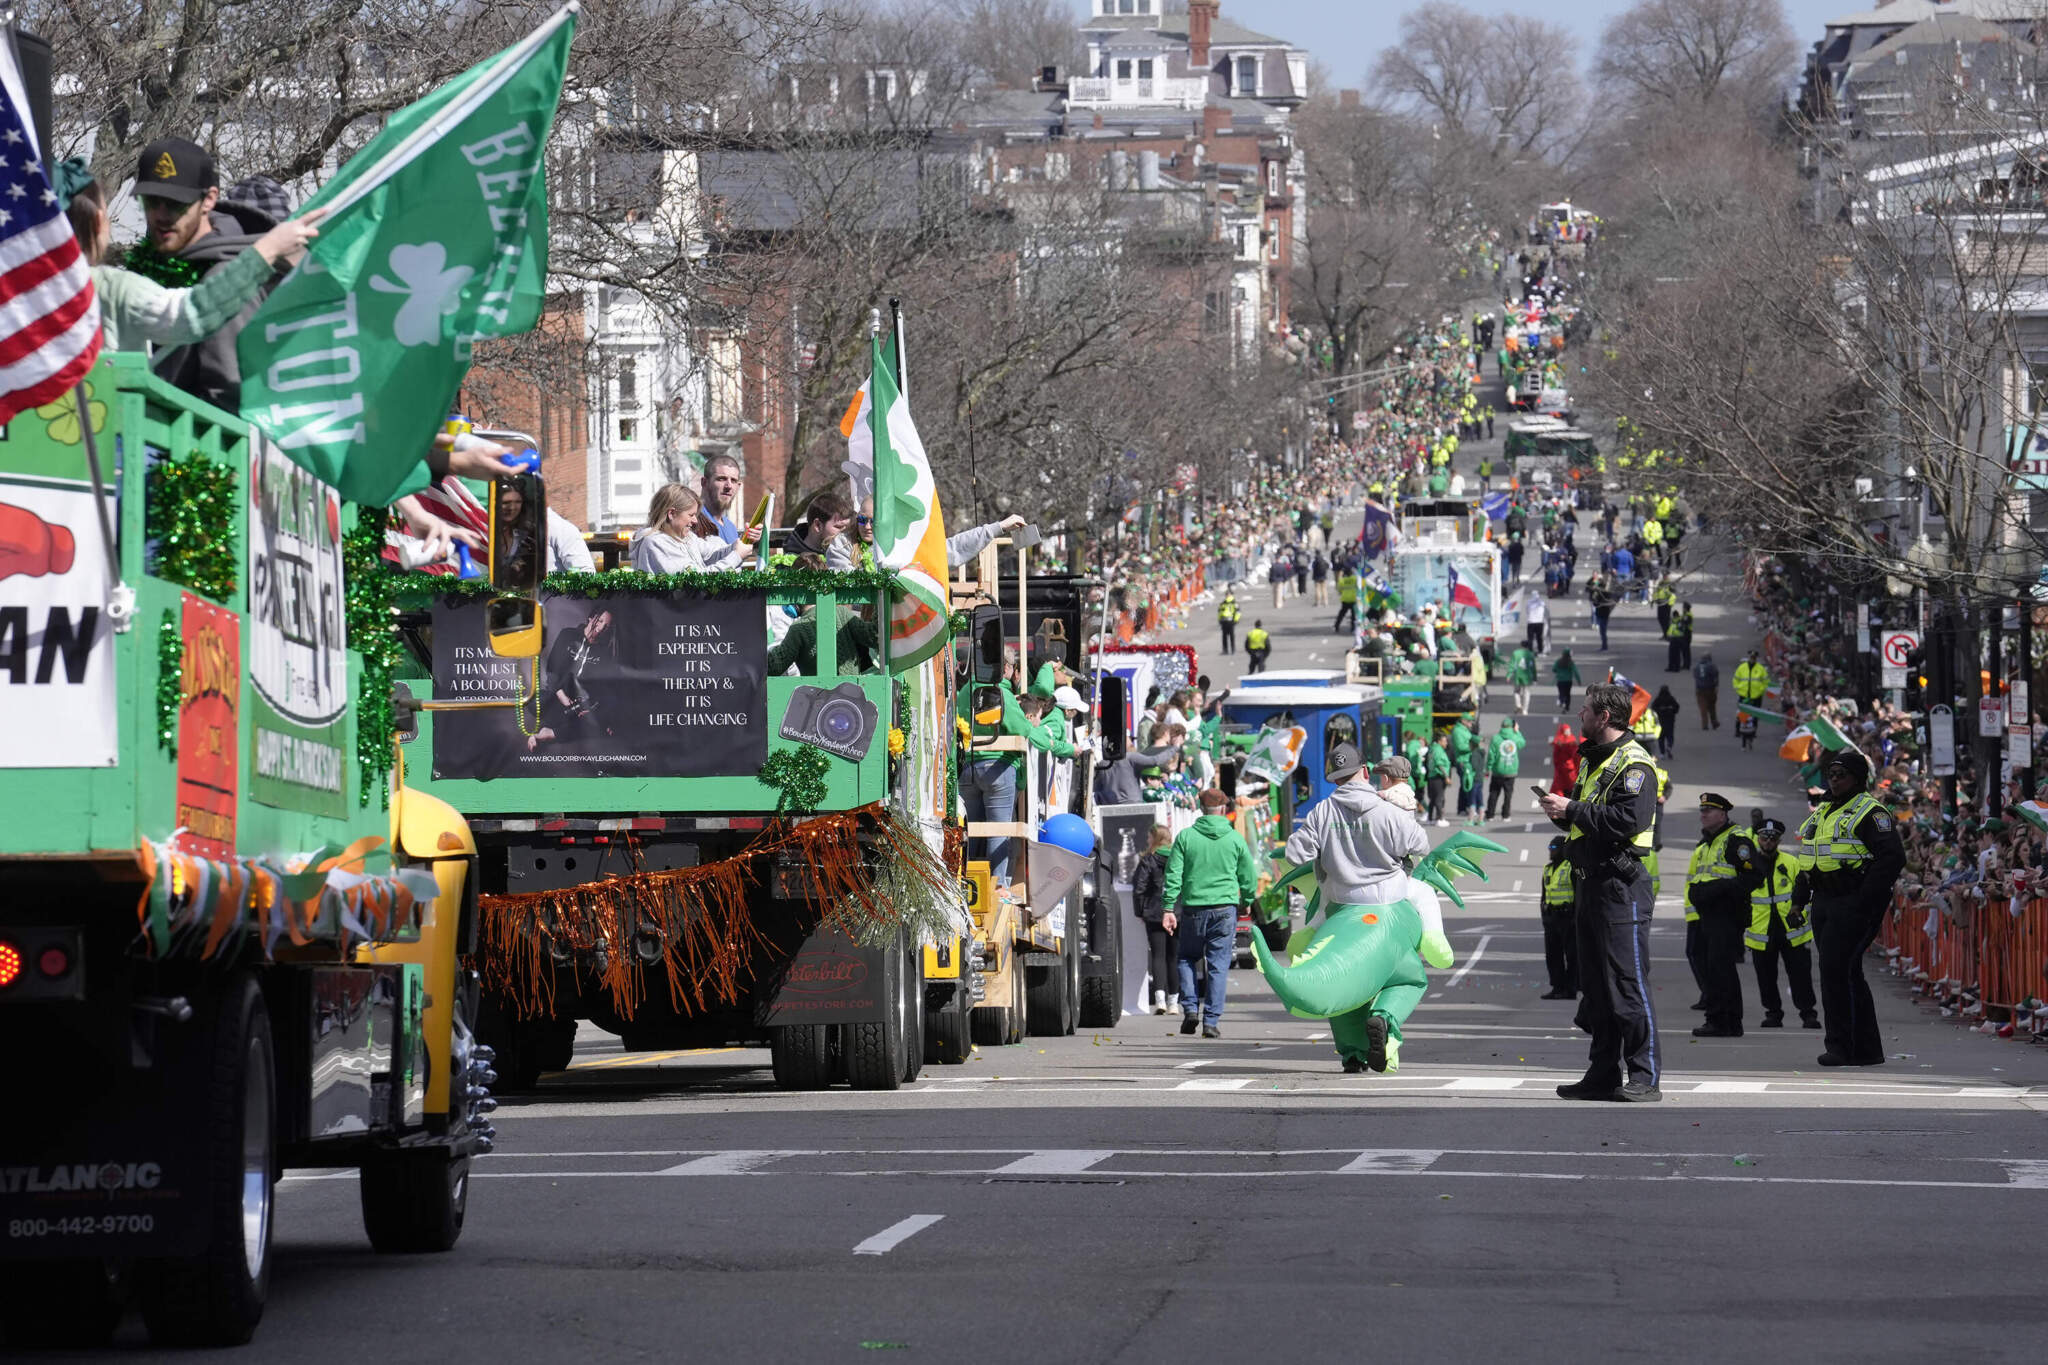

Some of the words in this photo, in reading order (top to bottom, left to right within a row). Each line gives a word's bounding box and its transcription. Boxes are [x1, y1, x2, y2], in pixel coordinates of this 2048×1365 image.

[265, 270, 366, 446] TON
[675, 624, 686, 637] IT
[689, 624, 701, 637] IS
[703, 624, 721, 637] AN
[658, 641, 738, 655] EXPERIENCE.
[454, 663, 488, 675] THAN
[490, 663, 518, 677] JUST
[686, 660, 697, 672] IT
[700, 660, 711, 672] IS
[450, 680, 459, 692] A
[461, 679, 522, 692] BOUDOIR
[662, 677, 721, 690] THERAPY
[723, 677, 735, 690] &
[686, 695, 697, 708] IT
[700, 695, 711, 708] IS
[649, 713, 675, 726] LIFE
[677, 712, 748, 726] CHANGING
[9, 1214, 155, 1238] 800-442-9700
